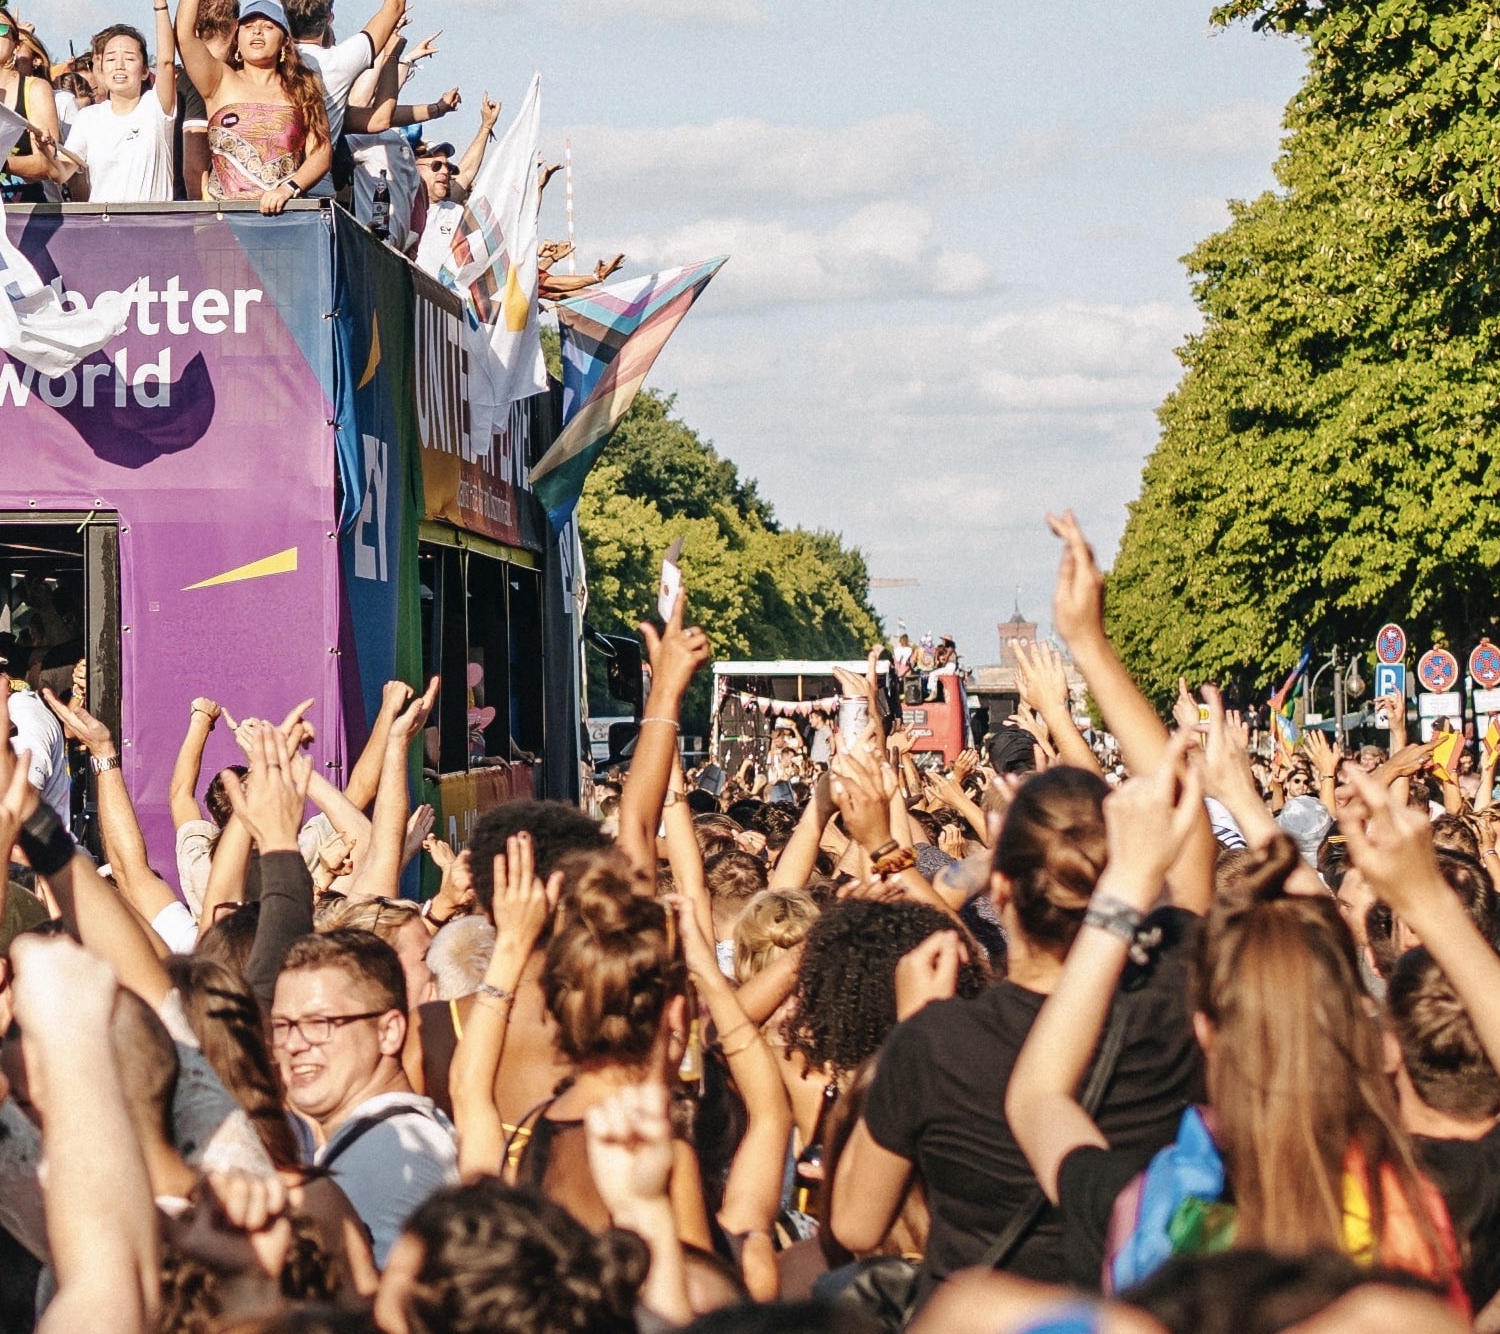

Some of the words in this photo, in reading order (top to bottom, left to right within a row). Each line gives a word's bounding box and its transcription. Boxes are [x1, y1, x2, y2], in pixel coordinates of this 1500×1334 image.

[414, 293, 478, 465] UNITE
[354, 433, 388, 582] EY
[1380, 668, 1397, 697] P
